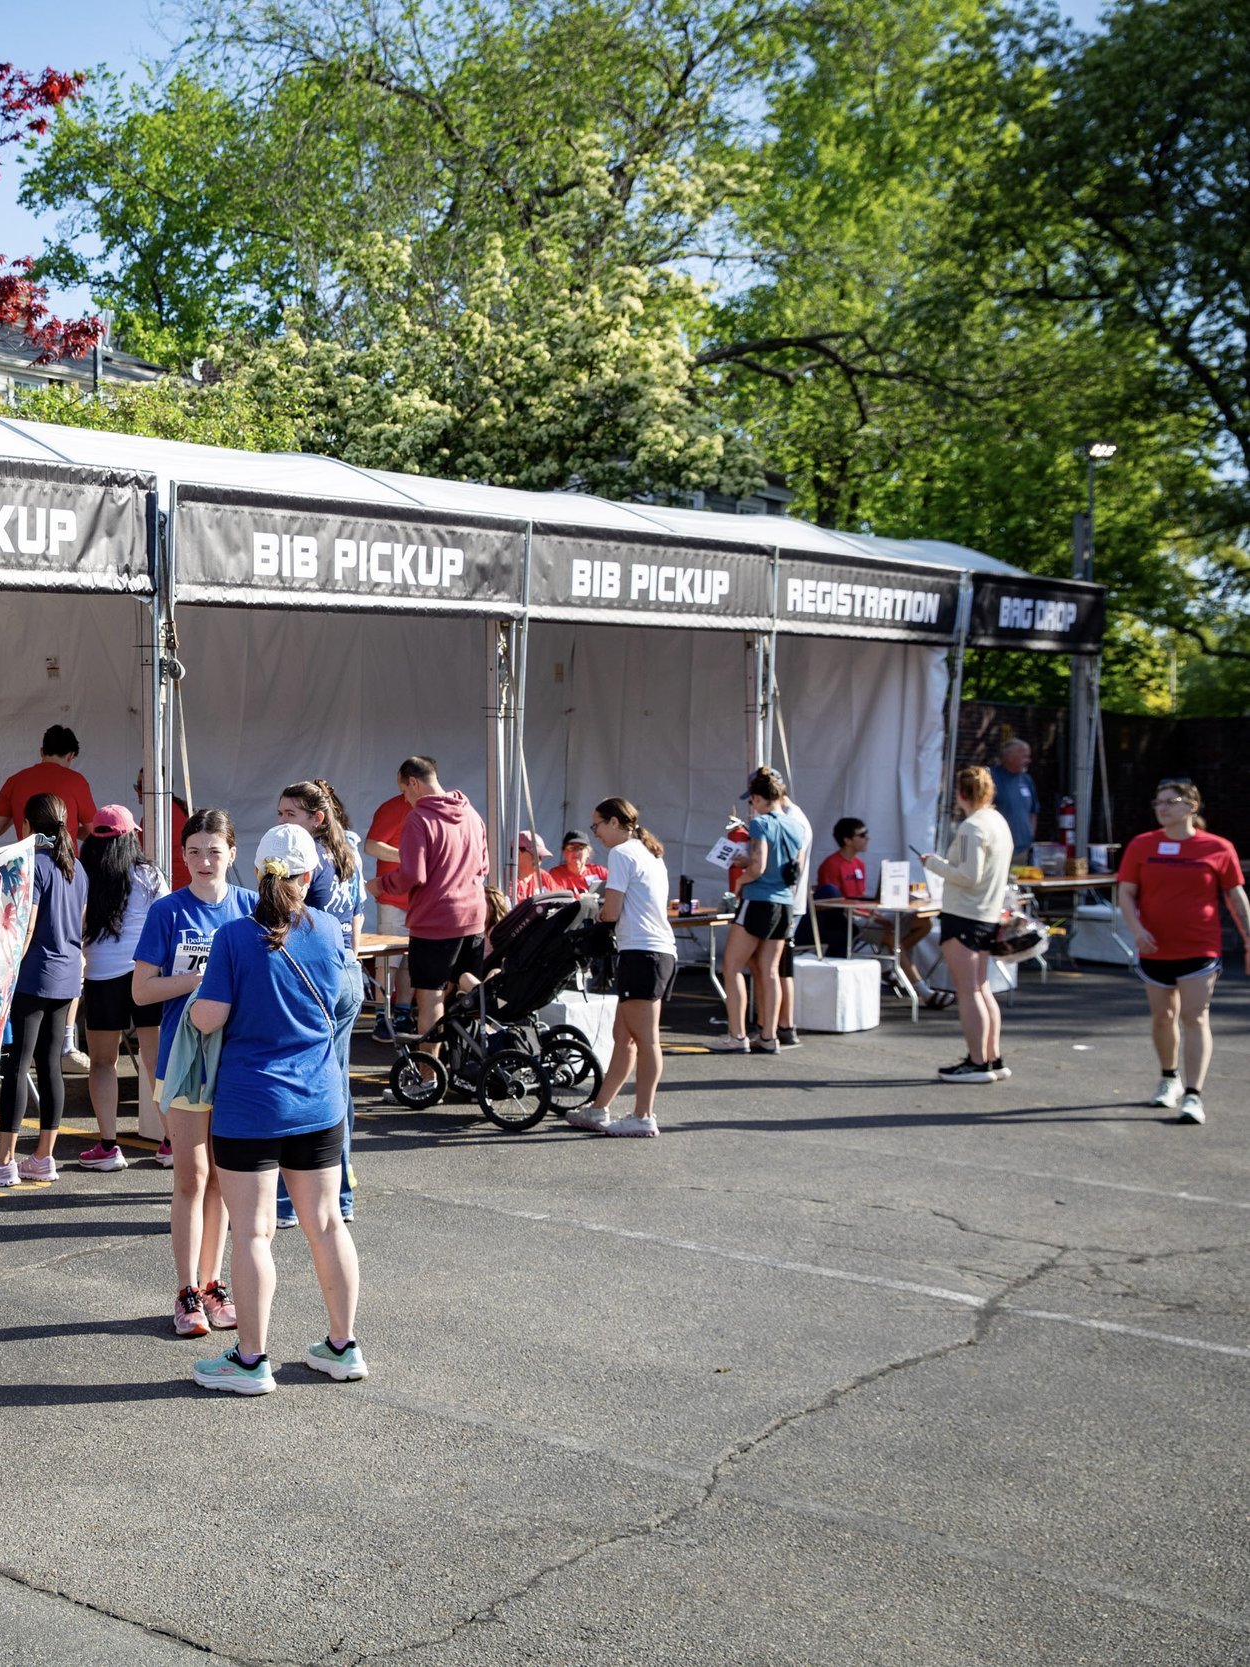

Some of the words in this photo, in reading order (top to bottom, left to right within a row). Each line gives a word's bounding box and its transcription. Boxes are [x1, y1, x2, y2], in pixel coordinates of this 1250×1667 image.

[253, 532, 318, 578] BIB
[334, 538, 464, 587] PICKUP
[571, 559, 621, 598] BIB
[630, 564, 730, 605] PICKUP
[786, 578, 941, 624] REGISTRATION
[998, 596, 1034, 629] BAG
[1034, 600, 1077, 632] DROP
